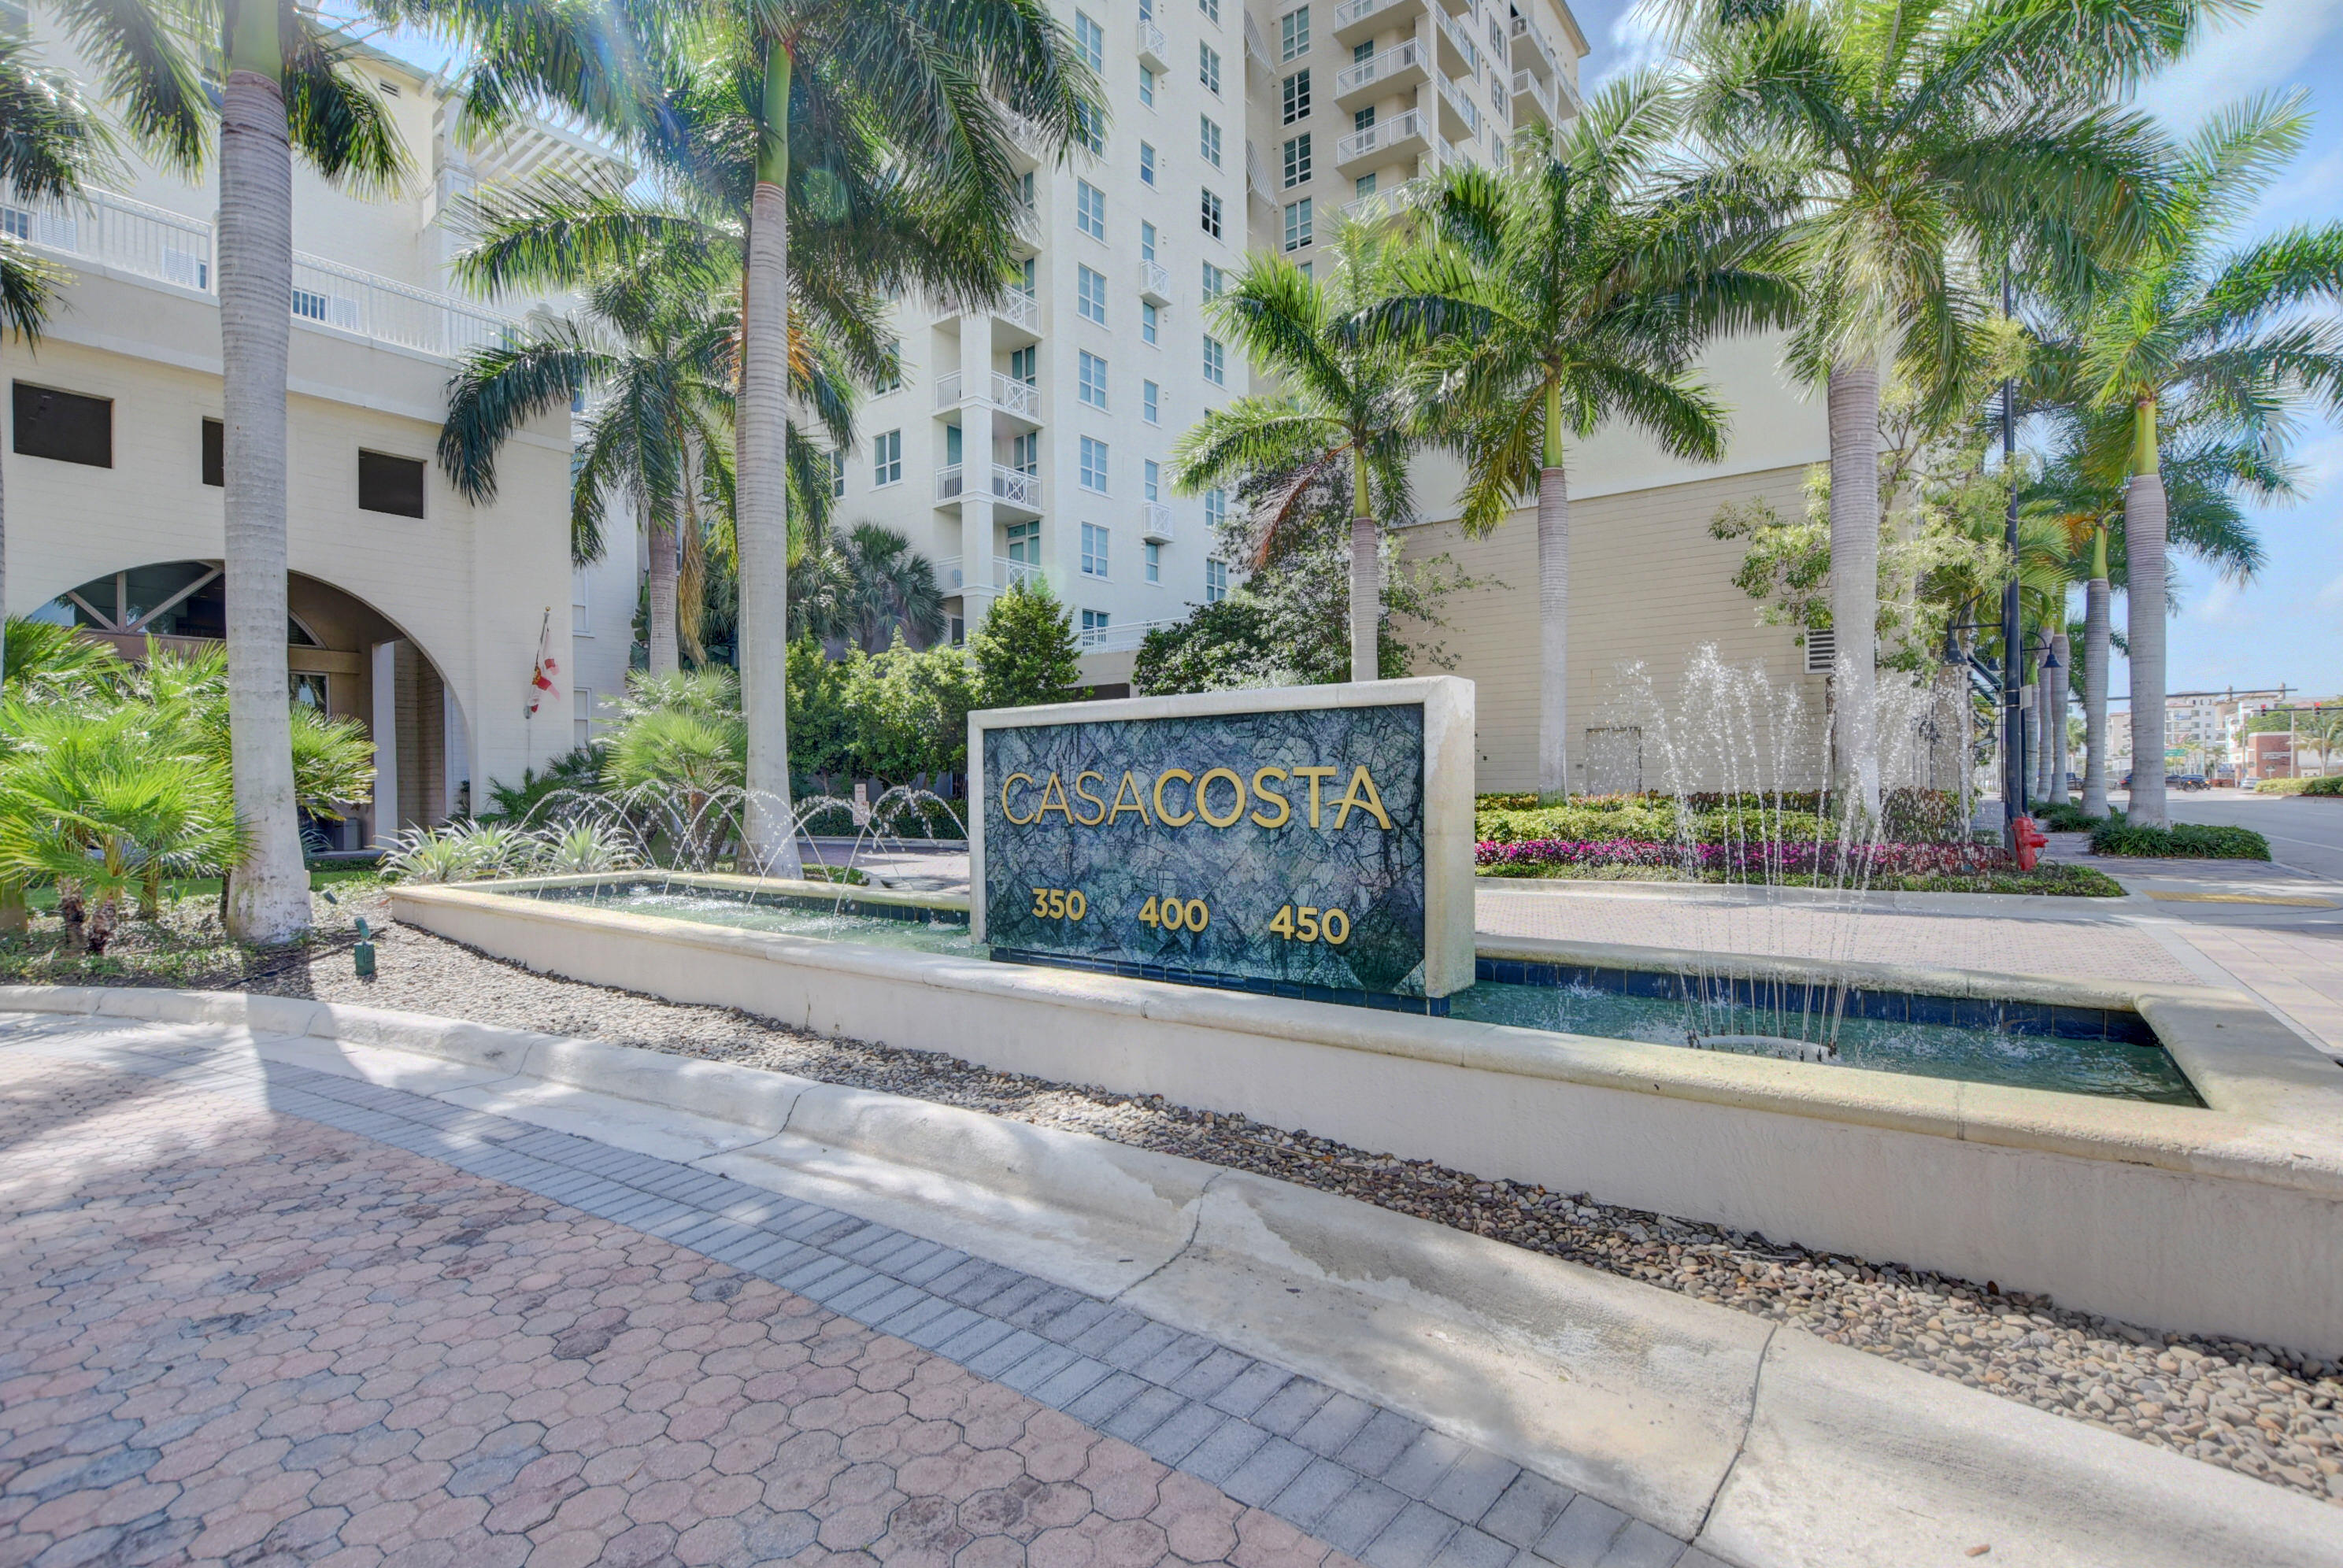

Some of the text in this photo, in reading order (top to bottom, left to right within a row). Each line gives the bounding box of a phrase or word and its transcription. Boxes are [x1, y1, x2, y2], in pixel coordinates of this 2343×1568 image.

[1001, 765, 1392, 830] CASACOSTA
[1032, 888, 1350, 945] 350 400 450
